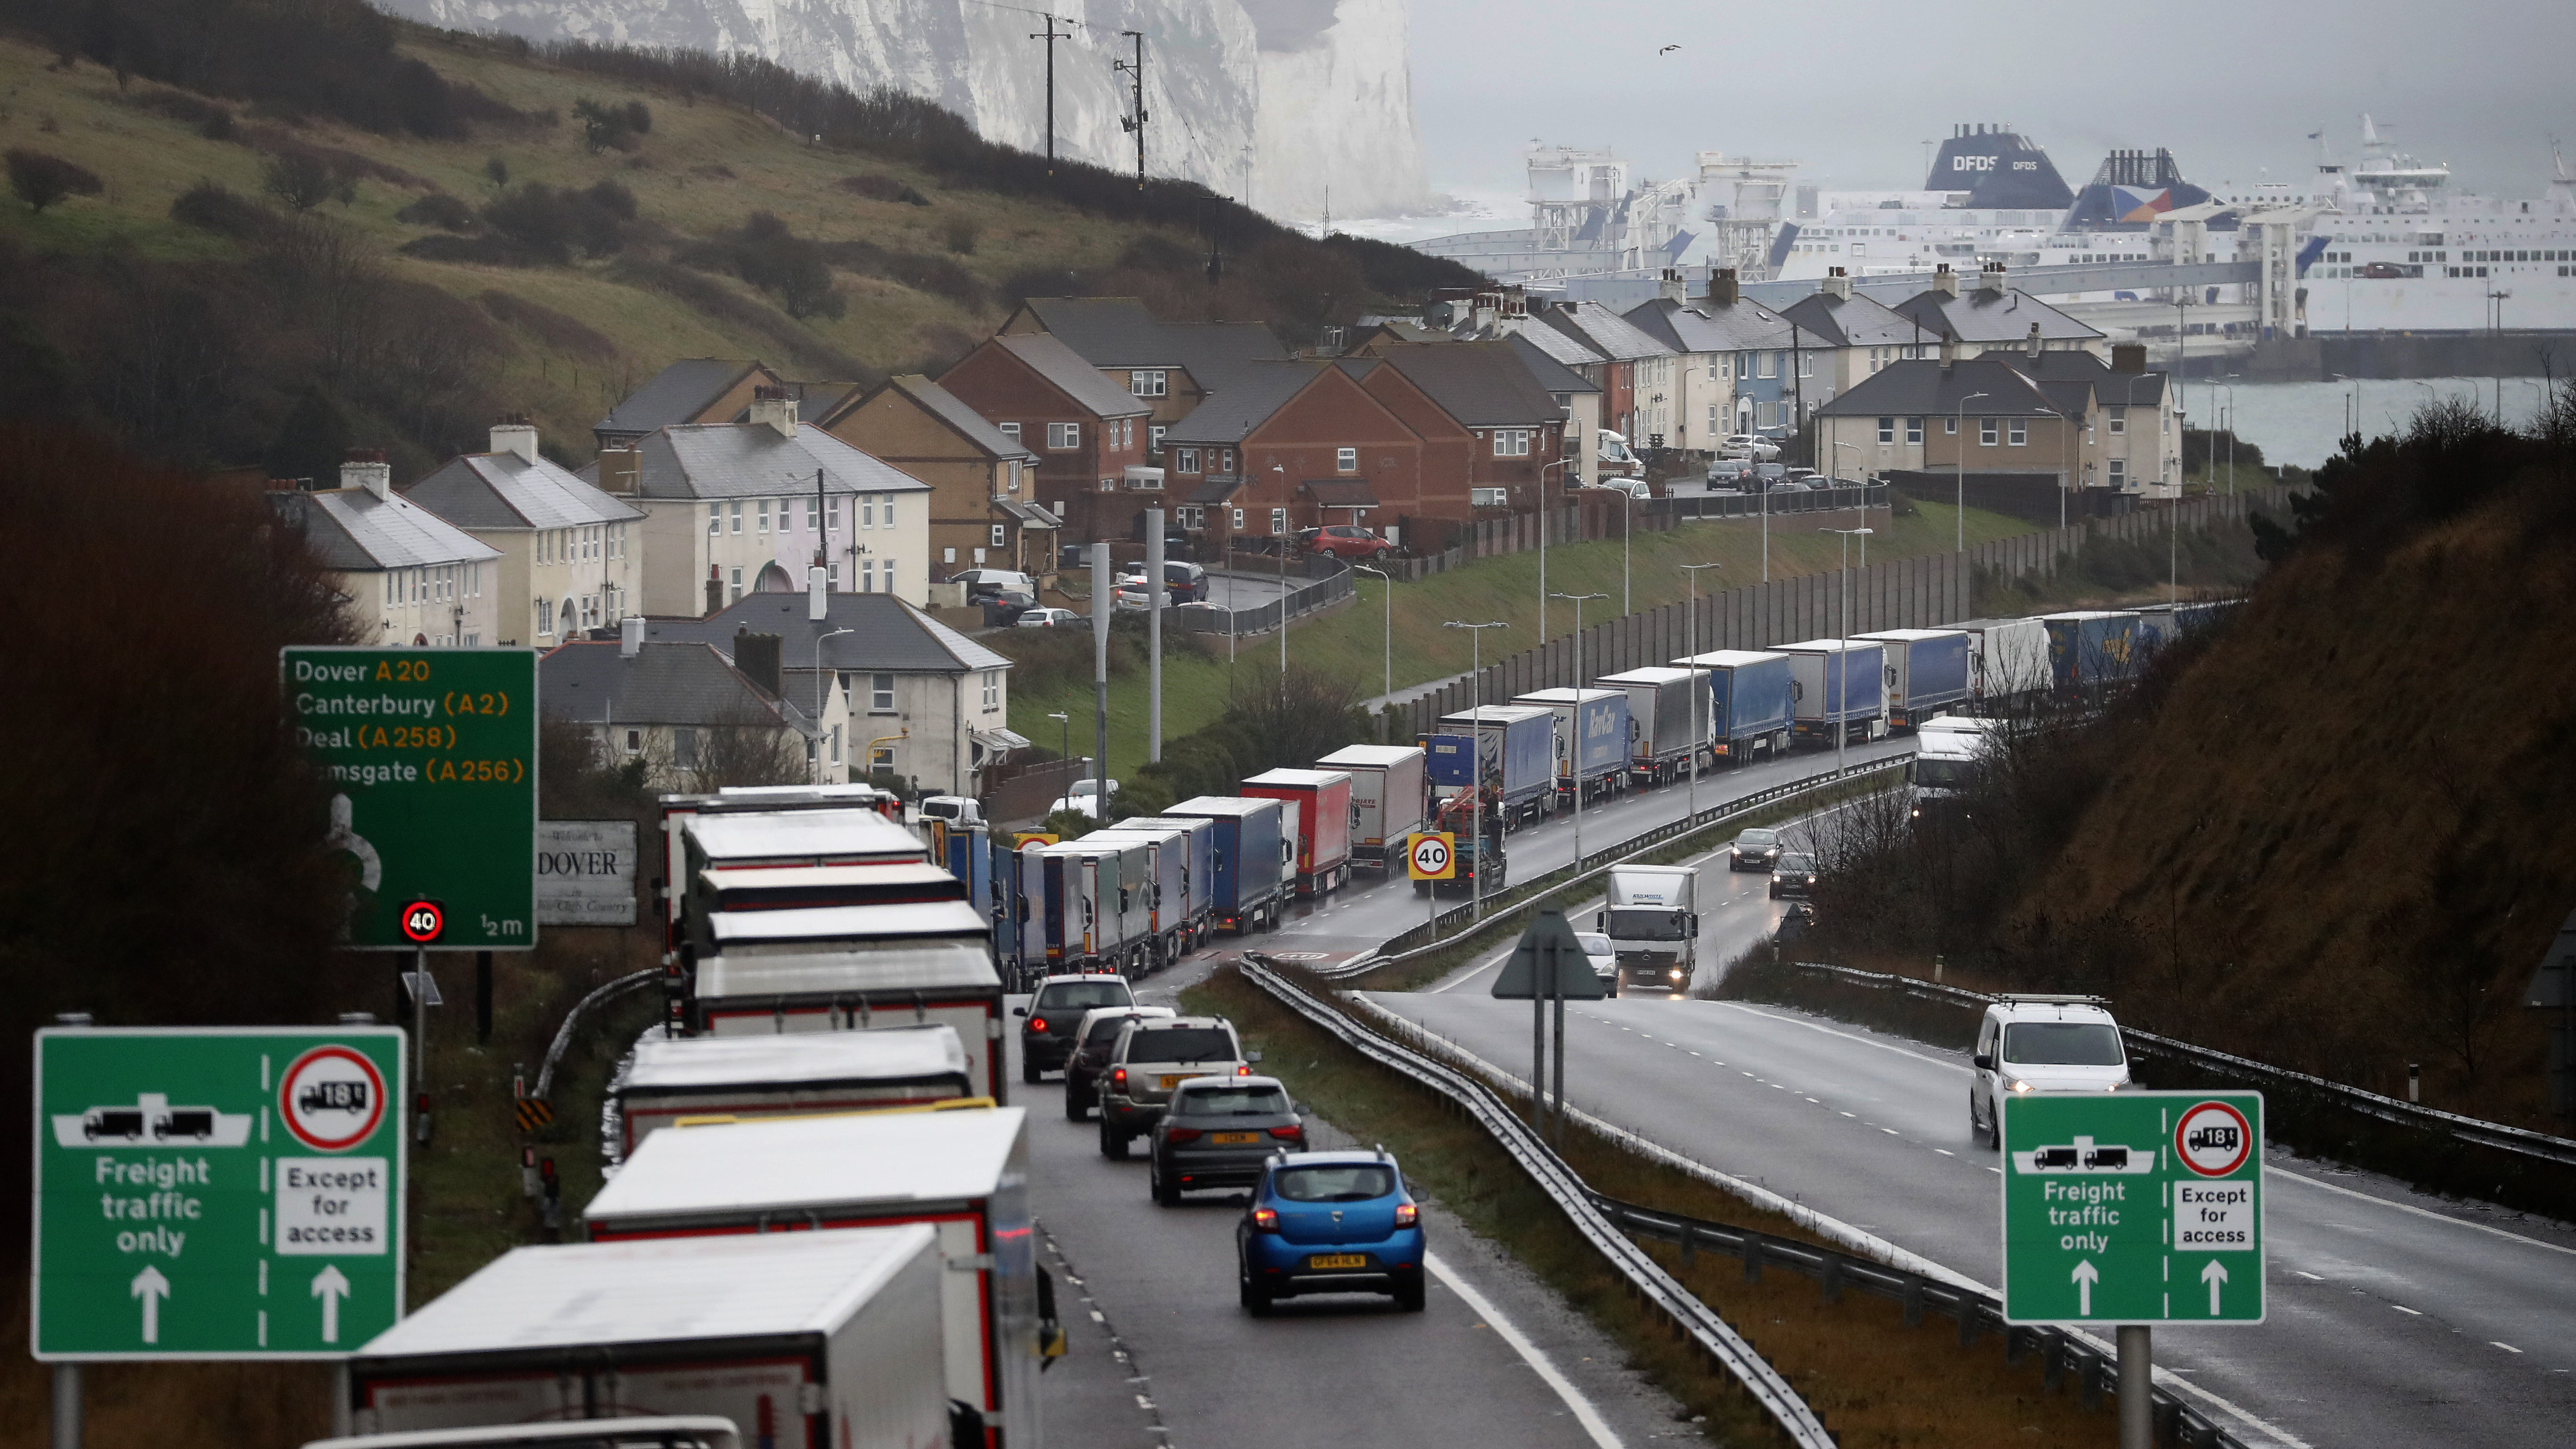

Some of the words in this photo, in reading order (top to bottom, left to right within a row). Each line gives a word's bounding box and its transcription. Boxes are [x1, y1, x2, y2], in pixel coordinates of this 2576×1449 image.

[1953, 155, 1999, 171] DFDS
[2012, 161, 2037, 170] DFDS
[295, 660, 369, 682] Dover
[375, 660, 430, 682] A20
[295, 693, 436, 719] Canterbury
[444, 691, 509, 717] (A2)
[358, 724, 457, 750] (A258)
[425, 758, 524, 784] (A256)
[538, 852, 617, 876] DOVER
[1417, 846, 1447, 866] 40
[409, 912, 436, 931] 40
[96, 1156, 210, 1190] Freight
[287, 1167, 377, 1191] Except
[2044, 1181, 2126, 1205] Freight
[2182, 1187, 2247, 1205] Except
[101, 1192, 202, 1220] traffic
[312, 1194, 349, 1216] for
[2048, 1205, 2120, 1226] traffic
[2200, 1207, 2227, 1223] for
[117, 1225, 186, 1258] only
[287, 1226, 375, 1243] access
[2061, 1230, 2109, 1254] only
[2182, 1230, 2246, 1243] access
